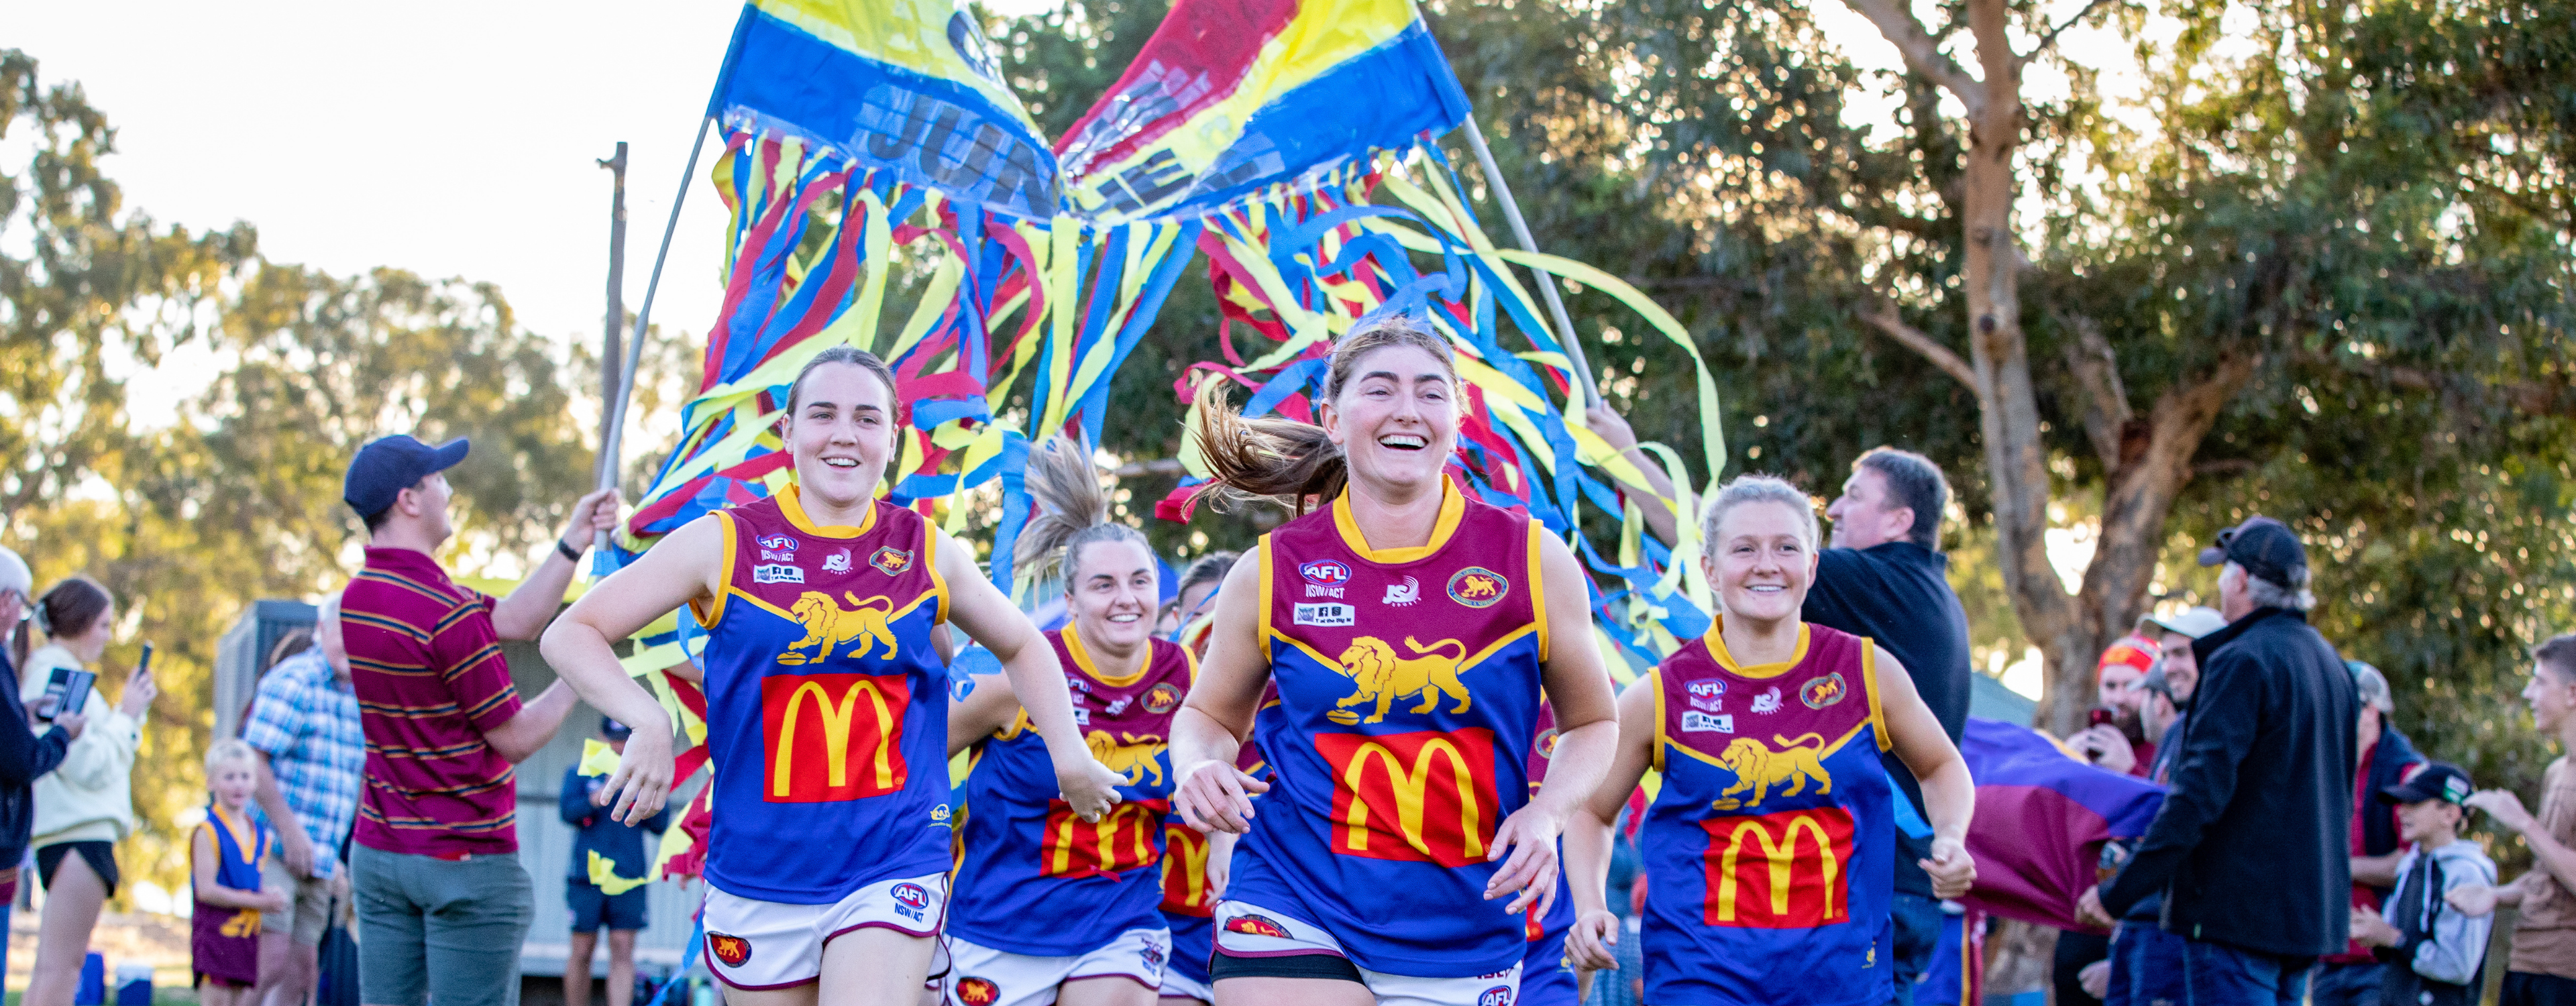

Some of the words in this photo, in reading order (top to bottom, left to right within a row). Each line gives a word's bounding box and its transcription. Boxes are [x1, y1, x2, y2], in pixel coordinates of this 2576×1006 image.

[761, 537, 794, 549] AFL
[1304, 565, 1347, 579] AFL
[1305, 583, 1345, 599] NSW/ACT
[1382, 582, 1413, 604] JS
[1688, 683, 1723, 696] AFL
[894, 886, 926, 907] AFL
[894, 902, 924, 924] NSW/ACT
[1483, 990, 1510, 1006] AFL
